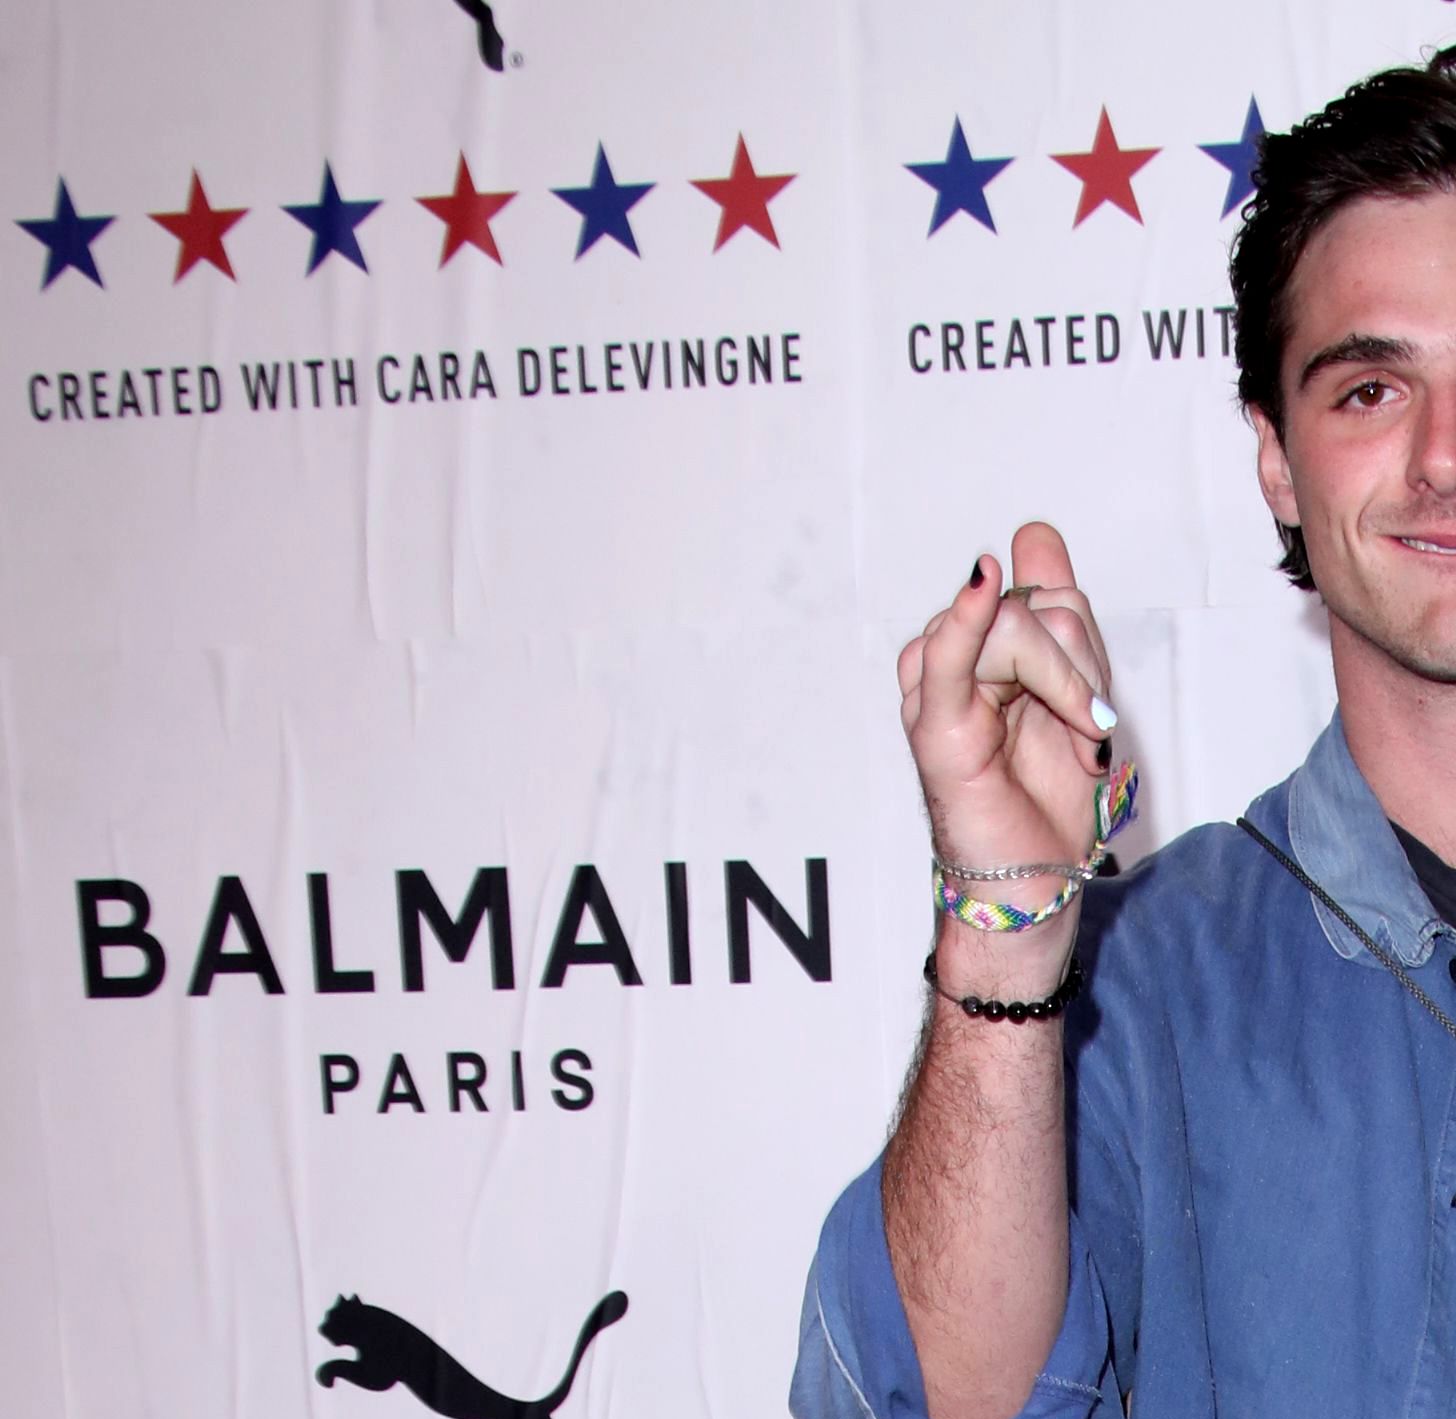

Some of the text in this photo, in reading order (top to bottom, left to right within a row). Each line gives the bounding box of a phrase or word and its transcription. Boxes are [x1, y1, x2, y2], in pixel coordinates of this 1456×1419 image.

[29, 333, 802, 423] CREATED WITH CARA DELEVINGNE
[908, 313, 1120, 374] CREATED
[76, 857, 832, 1000] BALMAIN
[320, 1048, 594, 1115] PARIS
